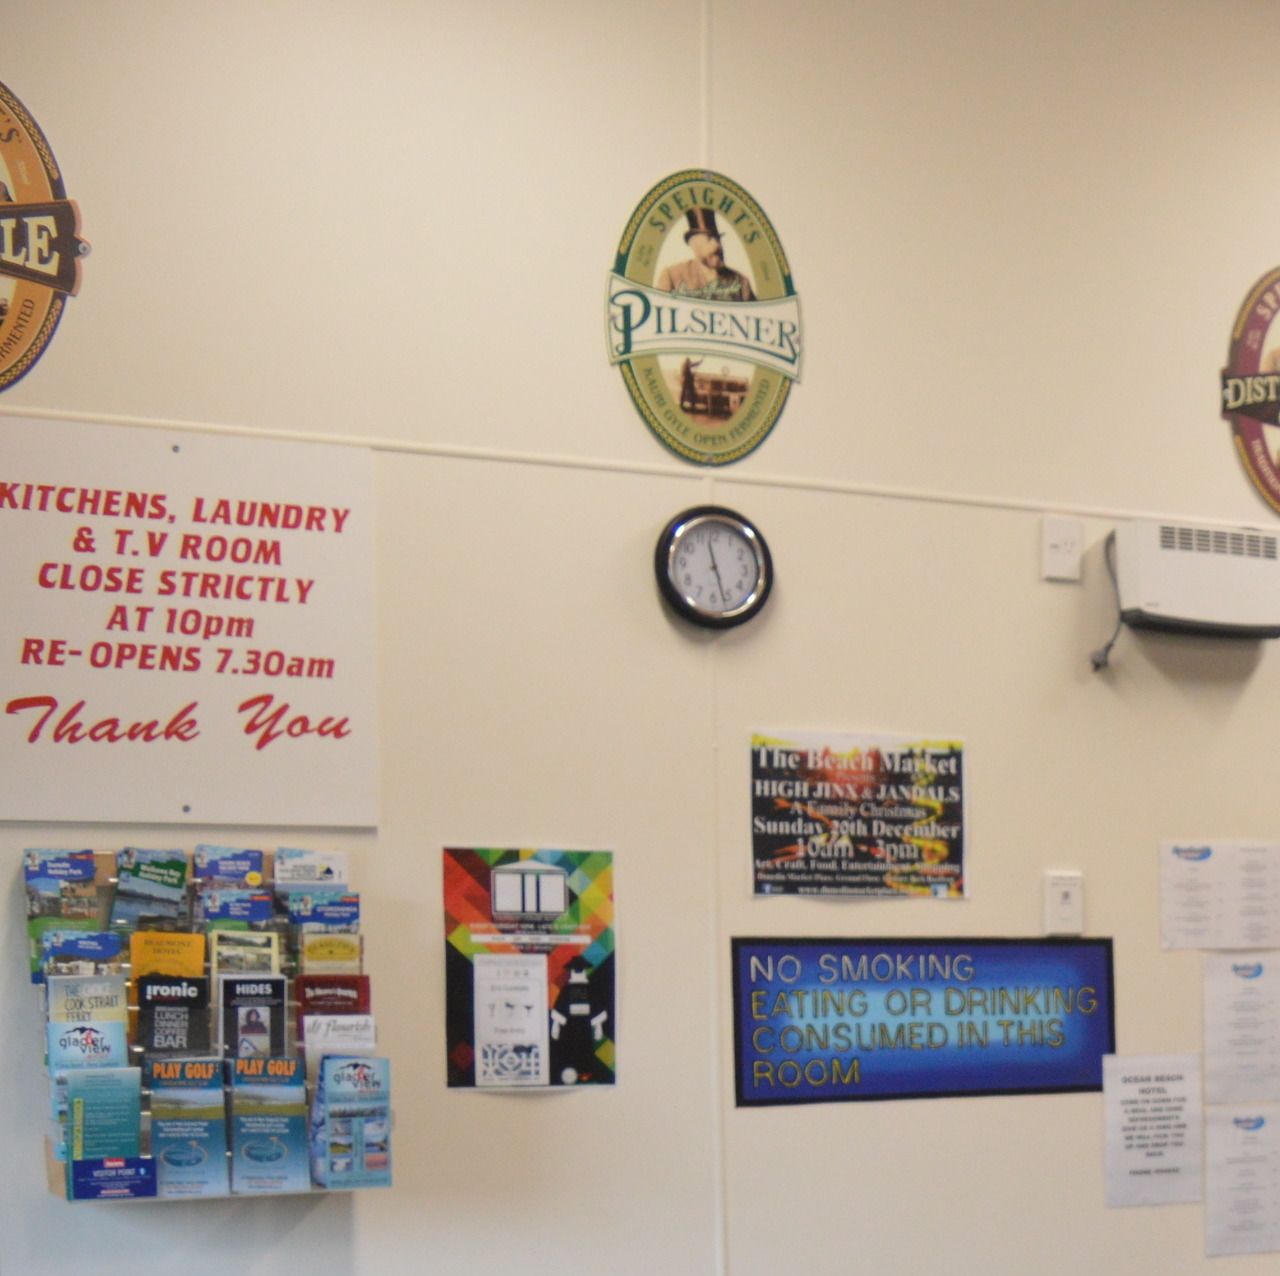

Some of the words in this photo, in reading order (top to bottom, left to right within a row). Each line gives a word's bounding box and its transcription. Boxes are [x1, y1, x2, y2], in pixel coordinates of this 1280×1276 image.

[649, 186, 760, 245] SPEIGHT'S
[609, 289, 799, 362] PILSENER
[0, 482, 177, 524] KITCHENS,
[191, 497, 351, 533] LAUNDRY
[72, 526, 96, 554] &
[115, 529, 168, 558] T.V
[180, 534, 283, 566] ROOM
[37, 562, 145, 595] CLOSE
[156, 570, 316, 604] STRICTLY
[106, 604, 154, 632] AT
[165, 608, 256, 641] 10pm
[20, 638, 202, 673] RE-OPENS
[215, 648, 336, 679] 7.30am
[5, 694, 201, 744] Thank
[237, 692, 352, 751] You
[757, 747, 801, 770] The
[807, 748, 876, 772] Beach
[879, 750, 958, 776] Market
[754, 779, 809, 799] HIGH
[812, 781, 859, 800] JINX
[876, 784, 961, 804] JANDALS
[859, 800, 927, 819] Christmas
[753, 815, 825, 839] Sunday
[872, 819, 961, 840] December
[749, 954, 801, 983] NO
[818, 953, 976, 984] SMOKING
[236, 983, 273, 995] HIDES
[751, 989, 869, 1020] EATING
[884, 989, 932, 1017] OR
[943, 987, 1098, 1016] DRINKING
[154, 1012, 189, 1021] LUNCH
[153, 1036, 188, 1049] BAR
[751, 1021, 949, 1053] CONSUMED
[958, 1020, 988, 1048] IN
[998, 1018, 1066, 1048] THIS
[153, 1062, 182, 1079] PLAY
[185, 1062, 216, 1079] GOLF
[236, 1059, 265, 1076] PLAY
[267, 1060, 297, 1076] GOLF
[752, 1058, 861, 1088] ROOM
